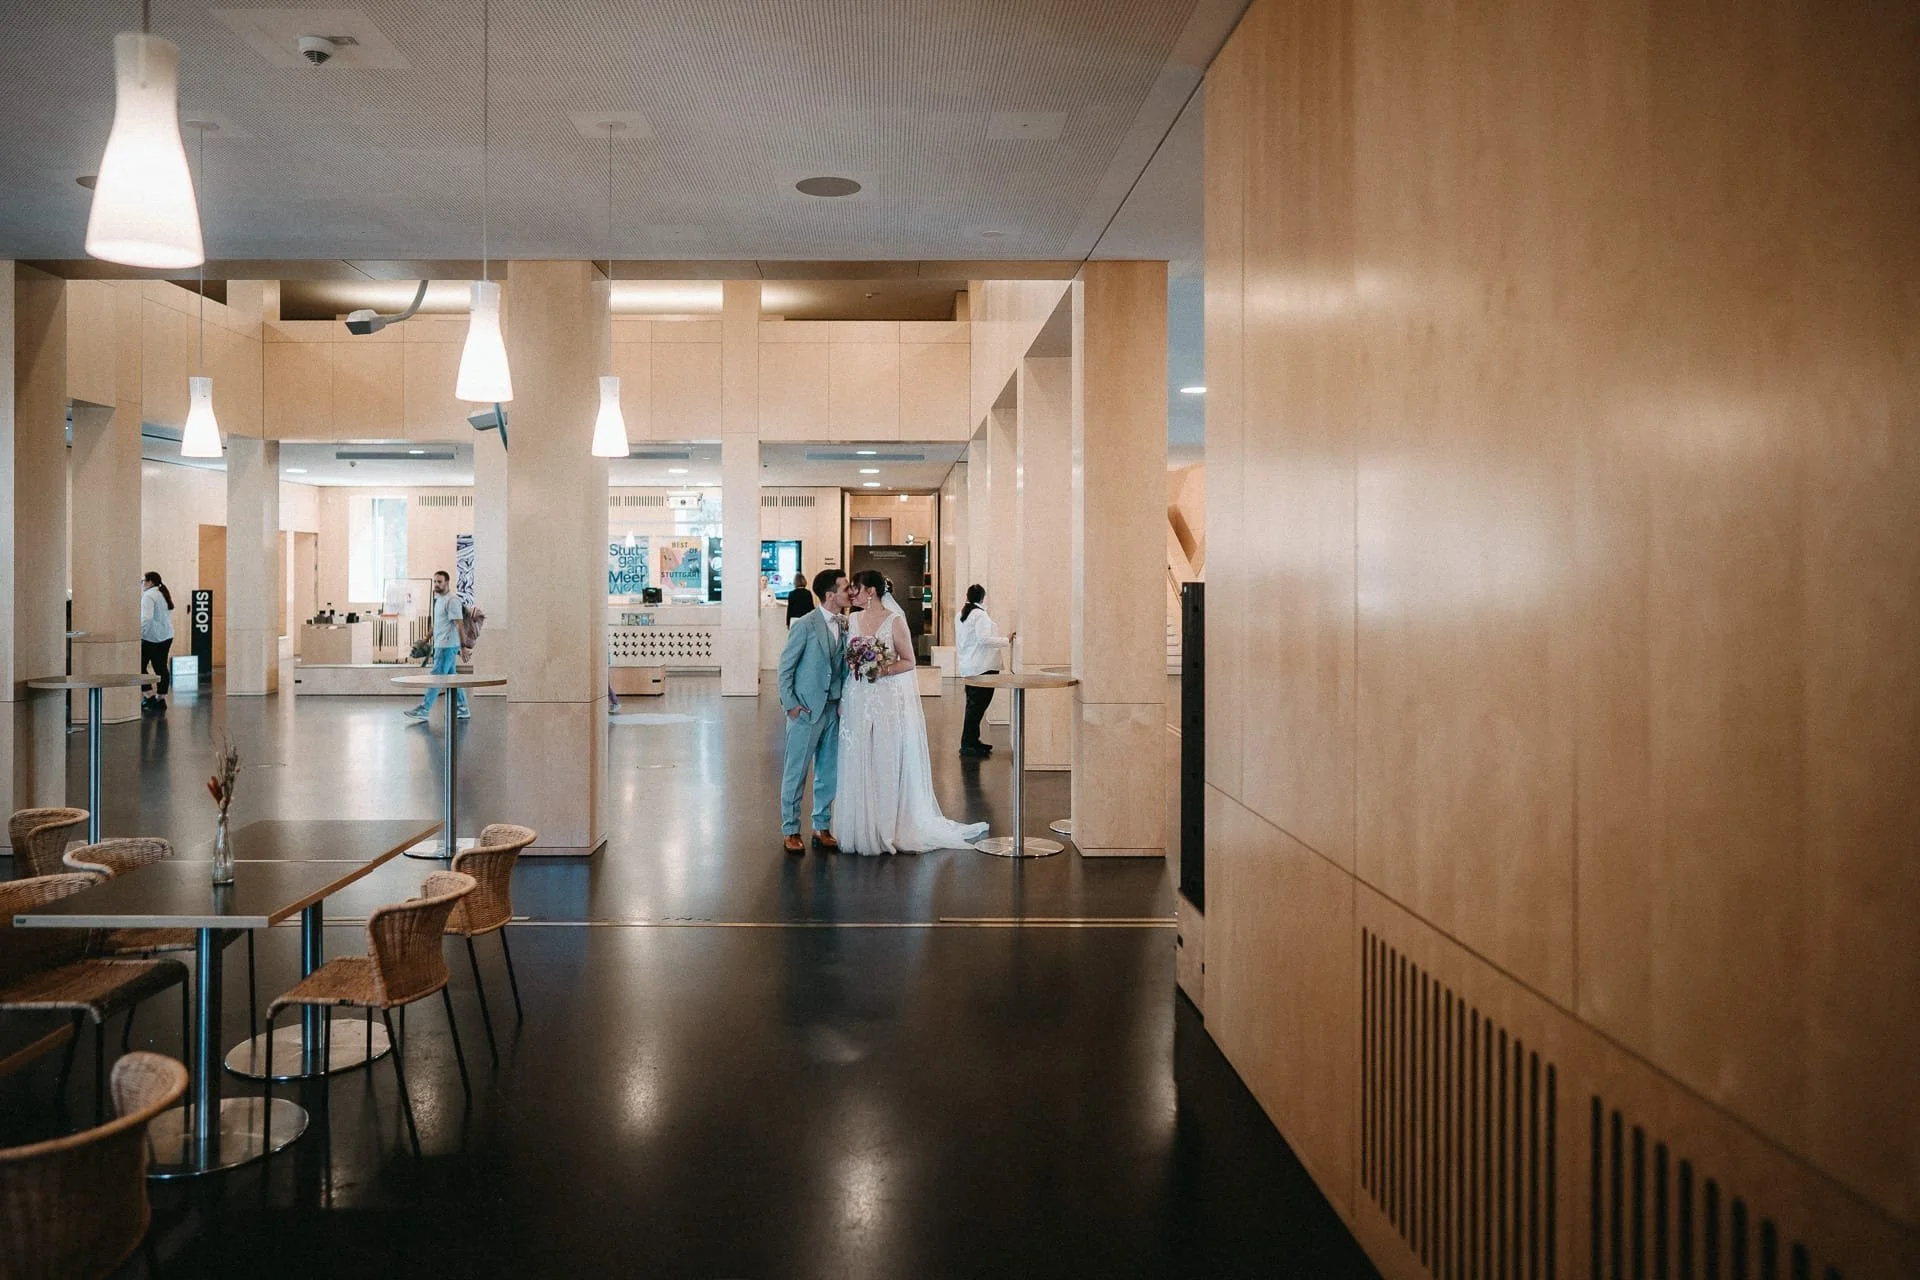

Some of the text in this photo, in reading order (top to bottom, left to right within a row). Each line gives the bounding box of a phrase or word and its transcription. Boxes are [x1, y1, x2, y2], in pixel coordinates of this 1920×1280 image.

[618, 553, 644, 568] gart
[608, 570, 645, 583] Meer
[627, 564, 649, 575] am
[195, 591, 209, 633] SHOP
